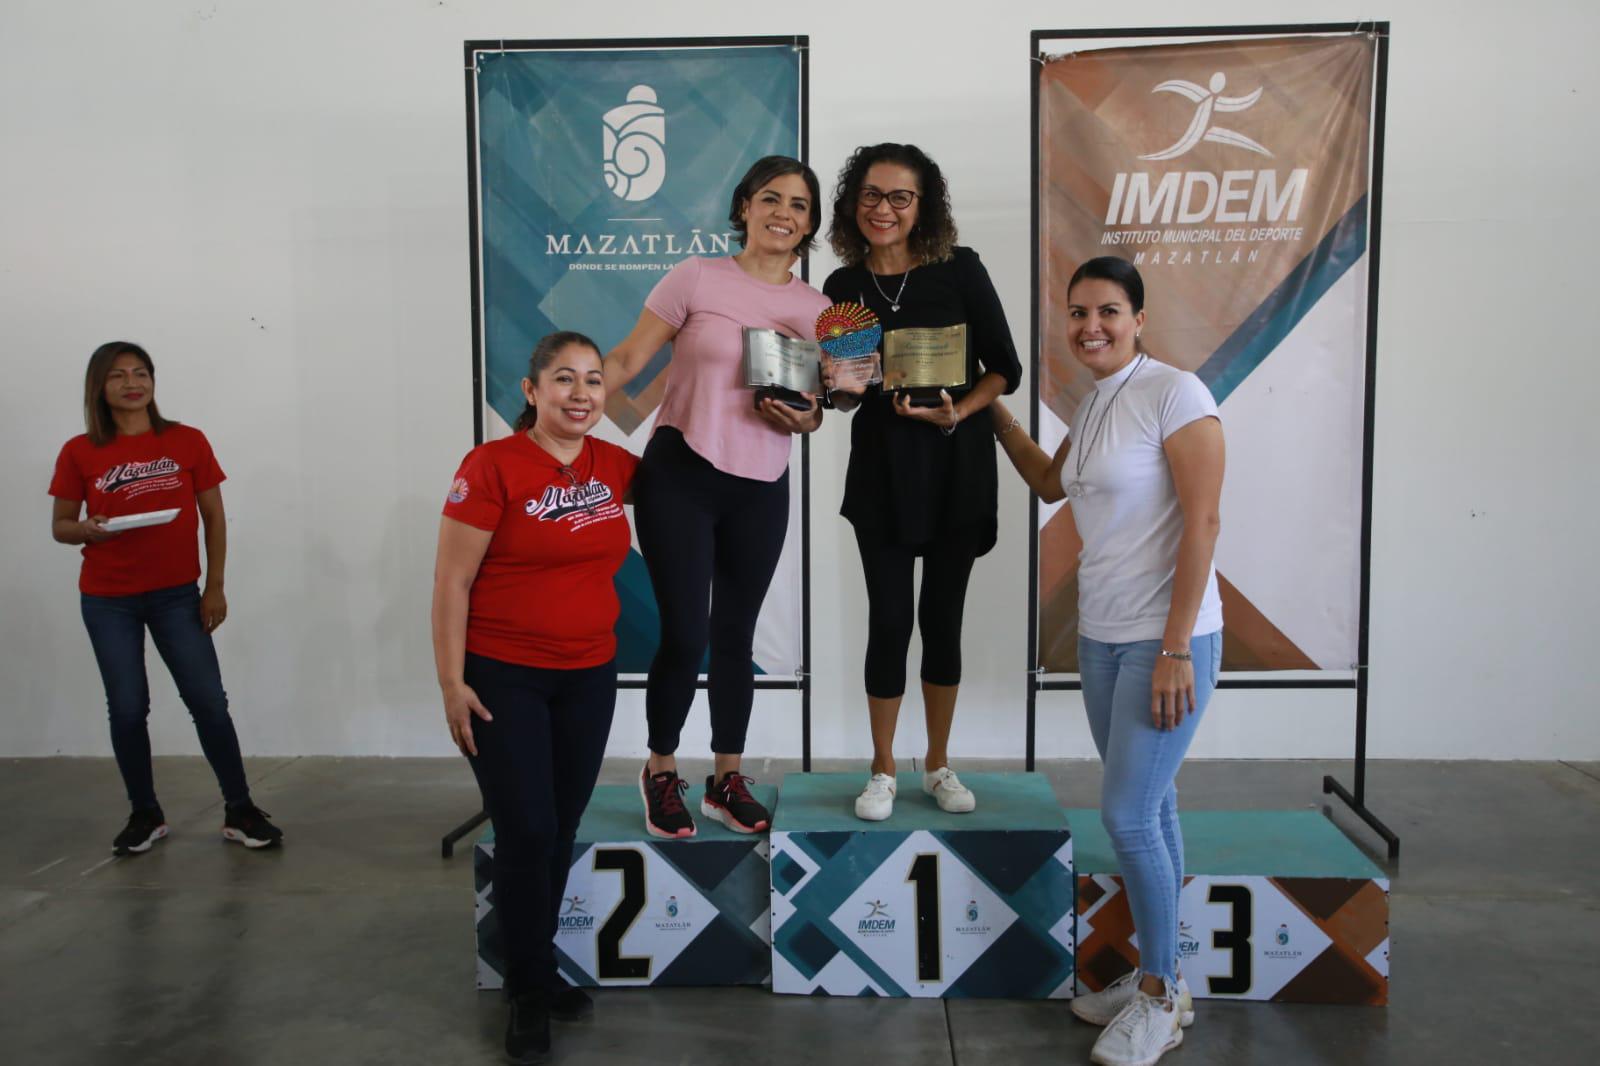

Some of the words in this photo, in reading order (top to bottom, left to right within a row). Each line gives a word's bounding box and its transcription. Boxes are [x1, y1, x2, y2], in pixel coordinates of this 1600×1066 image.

[1104, 168, 1309, 225] IMDEM
[1101, 230, 1161, 245] INSTITUTO
[1162, 229, 1221, 244] MUNICIPAL
[1224, 228, 1247, 242] DEL
[1250, 226, 1304, 241] DEPORTE
[1133, 247, 1259, 266] MAZATLÁN
[569, 263, 603, 271] DONDE
[605, 263, 618, 271] SE
[619, 263, 662, 271] ROMPEN
[558, 916, 594, 927] MDEM
[592, 847, 652, 980] 2
[905, 852, 942, 983] 1
[858, 919, 896, 930] IMDEM
[1206, 883, 1253, 995] 3
